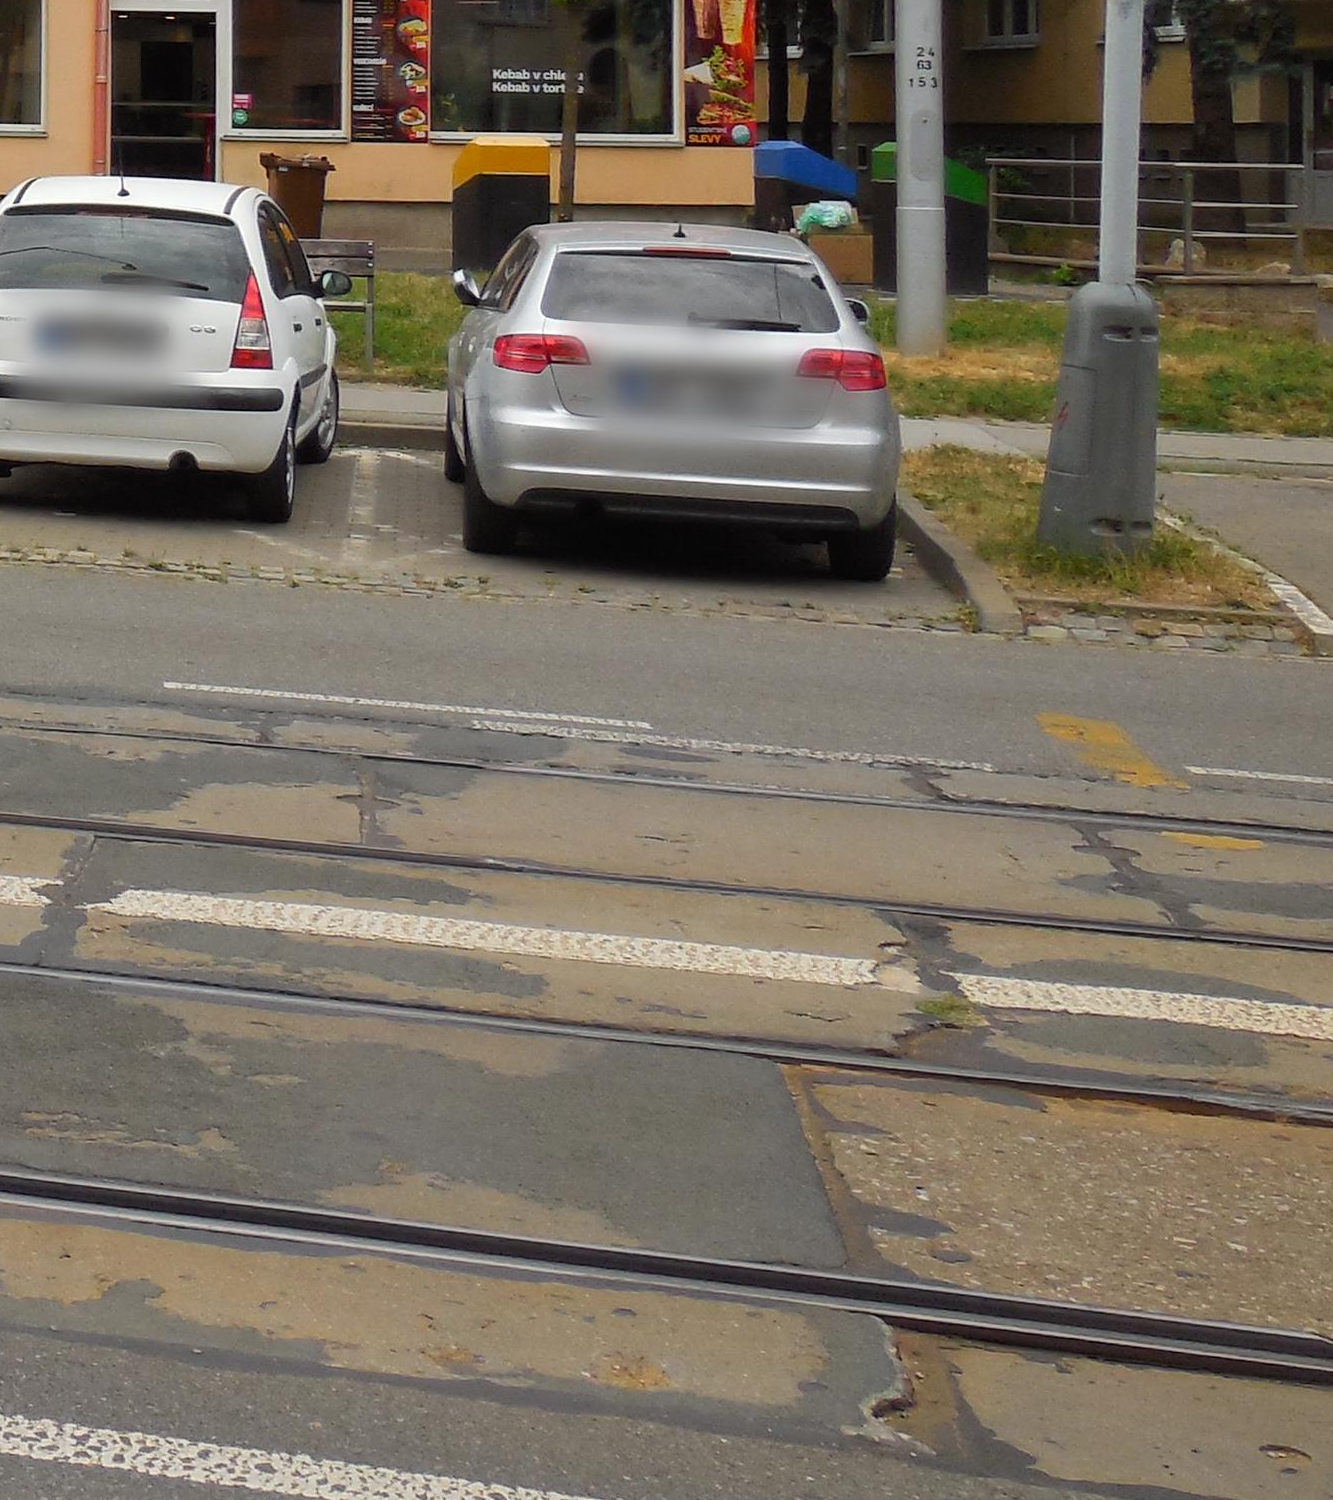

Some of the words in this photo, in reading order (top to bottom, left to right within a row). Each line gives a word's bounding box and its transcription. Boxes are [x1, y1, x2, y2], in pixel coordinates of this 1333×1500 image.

[917, 46, 935, 57] 24
[917, 59, 932, 70] 63
[492, 69, 530, 79] Kebab
[533, 72, 541, 80] v
[492, 82, 530, 92] Kebab
[533, 85, 540, 93] v
[909, 76, 938, 88] 153
[688, 134, 722, 143] SLEVY
